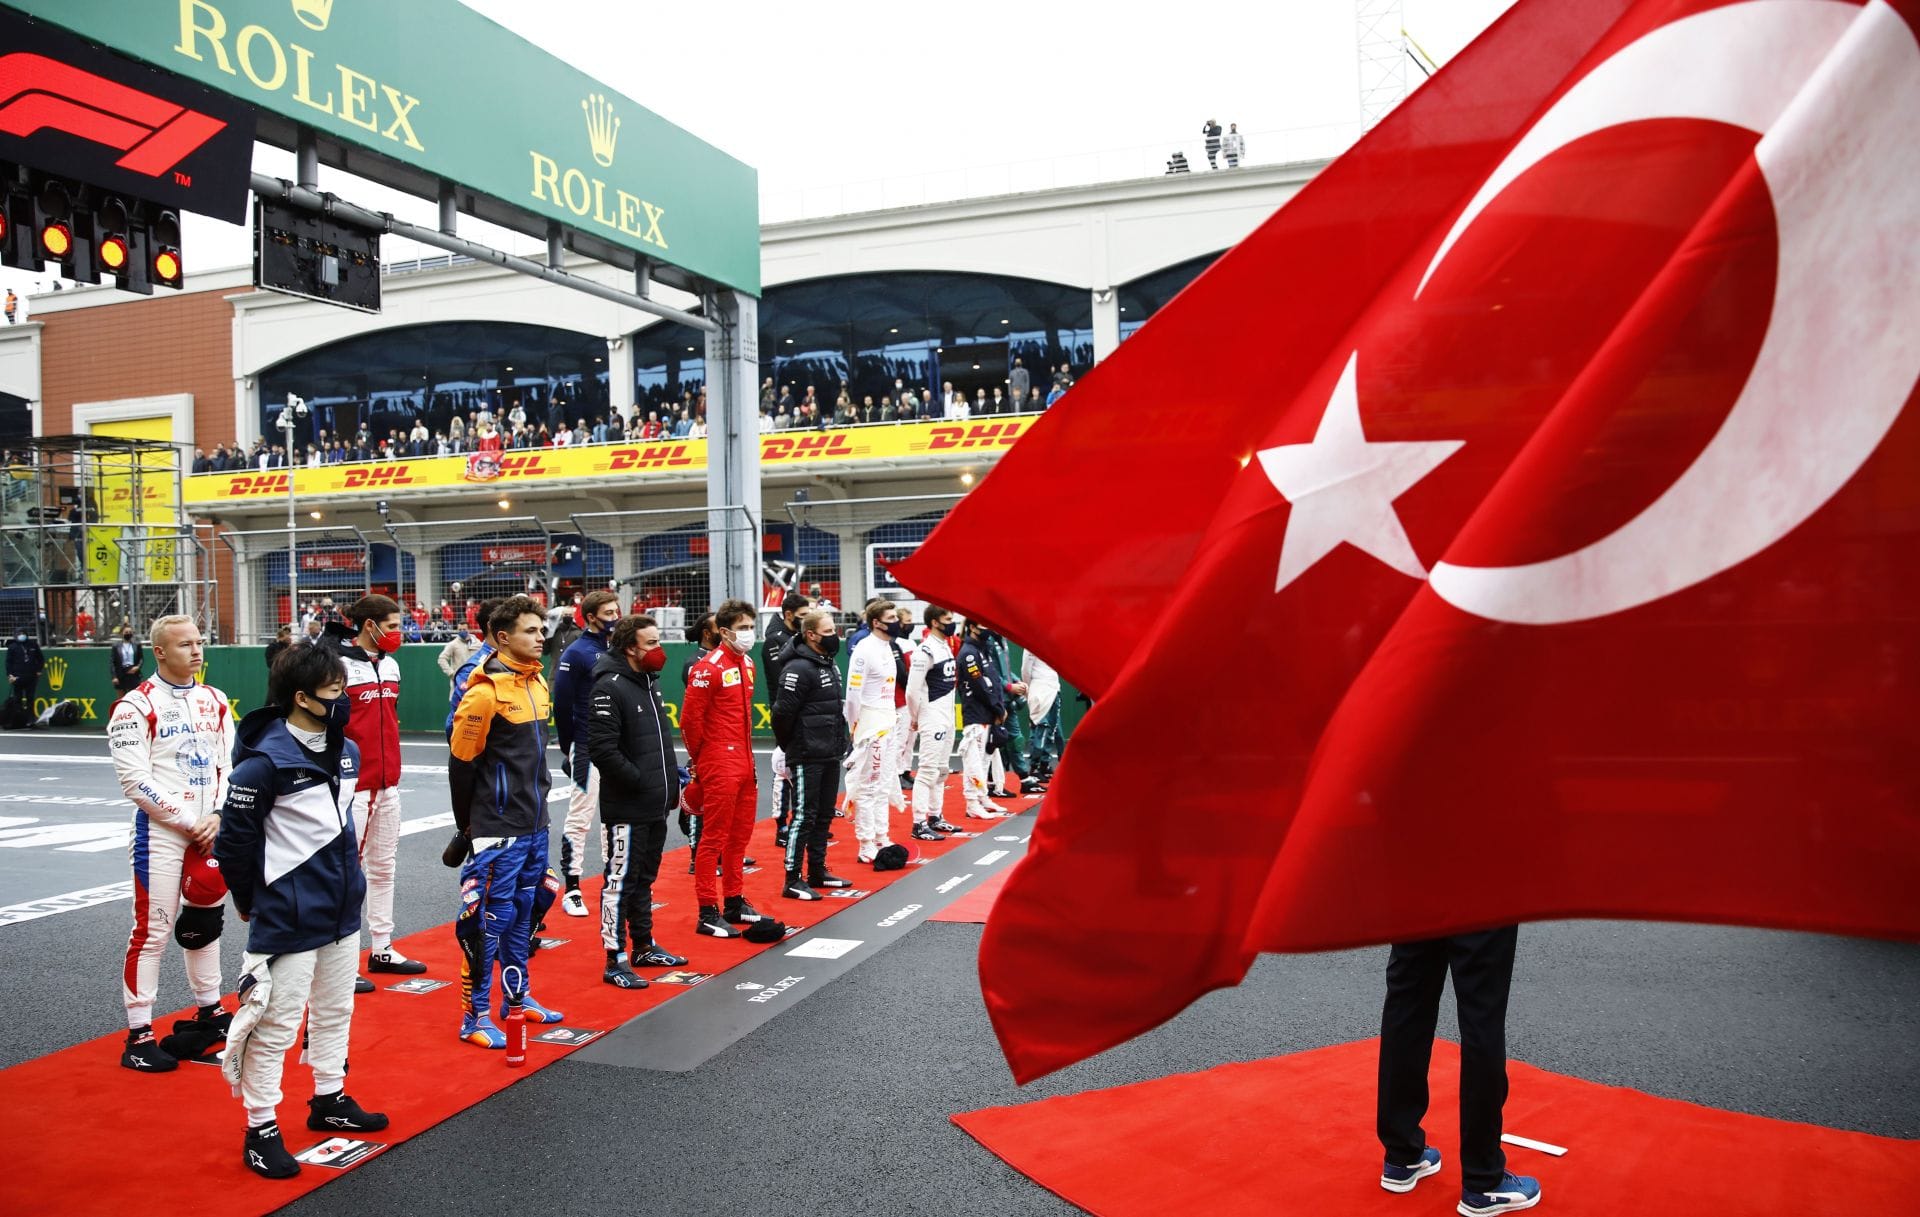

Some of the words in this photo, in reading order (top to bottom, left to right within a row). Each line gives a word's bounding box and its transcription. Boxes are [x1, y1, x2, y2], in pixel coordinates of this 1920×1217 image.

[174, 0, 425, 152] ROLEX
[174, 171, 191, 187] TM
[529, 150, 668, 249] ROLEX
[761, 434, 852, 460] DHL
[928, 423, 1022, 449] DHL
[498, 456, 546, 477] HL
[609, 445, 692, 469] DHL
[229, 474, 292, 495] DHL
[344, 466, 413, 488] DHL
[358, 689, 380, 703] Alfa
[747, 975, 806, 1003] ROLEX
